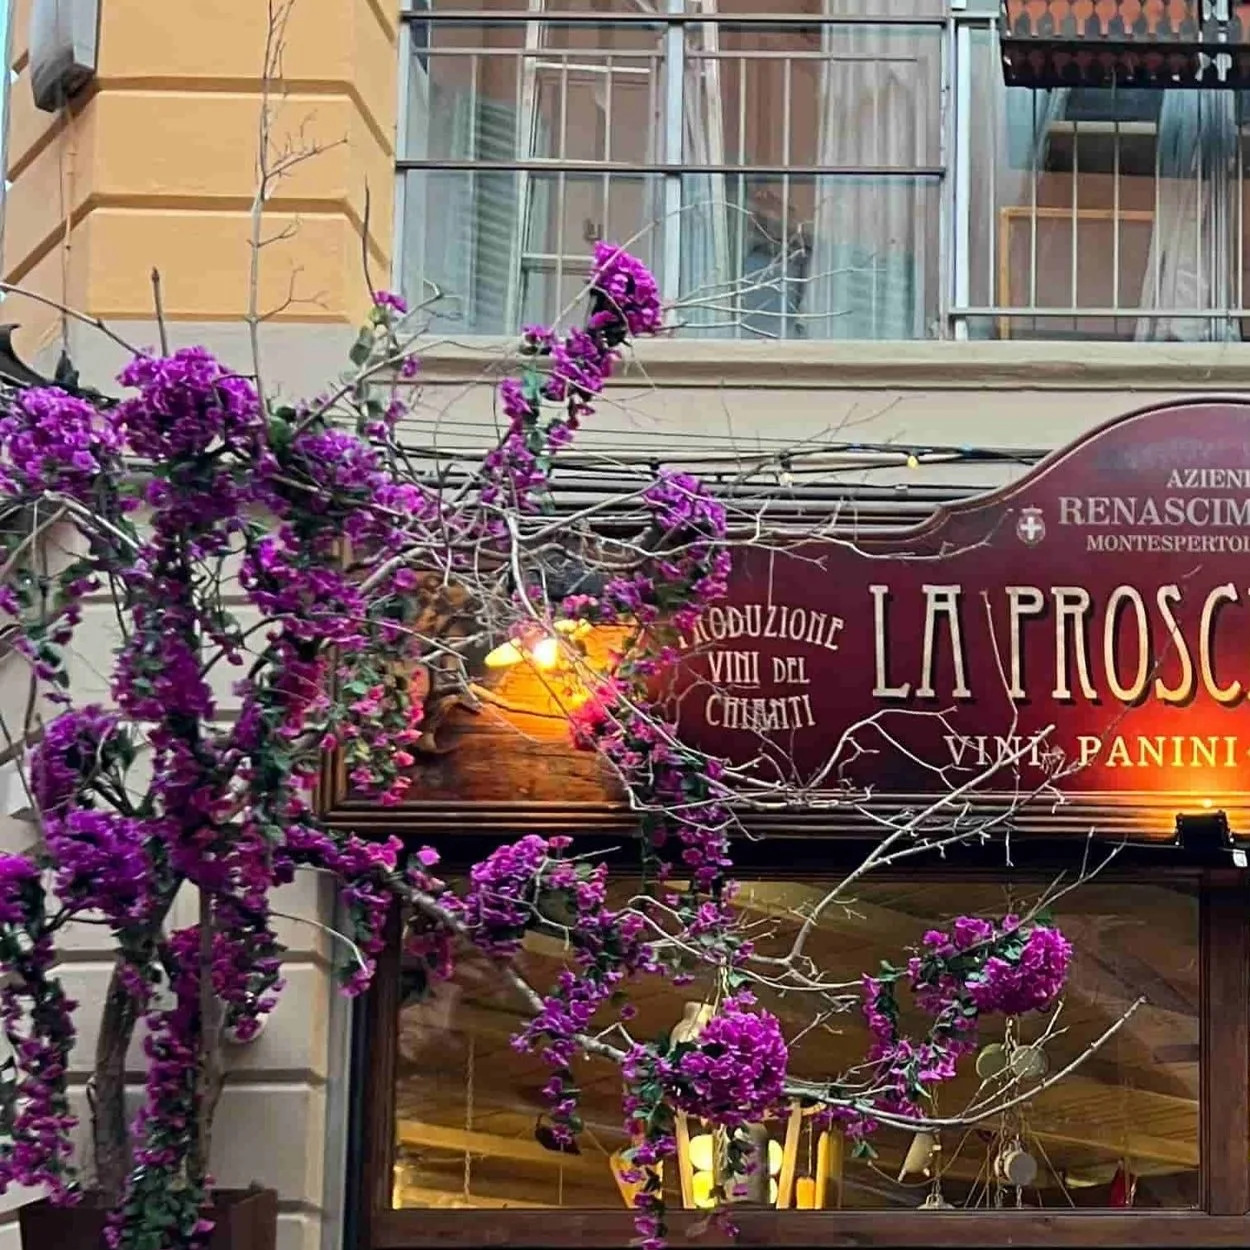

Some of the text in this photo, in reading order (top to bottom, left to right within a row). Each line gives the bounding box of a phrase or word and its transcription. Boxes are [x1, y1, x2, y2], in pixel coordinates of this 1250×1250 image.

[678, 604, 844, 651] RODUZIONE
[868, 583, 970, 700] LA
[708, 651, 811, 684] VINI DEL
[705, 693, 816, 730] CHIANTI
[943, 735, 1042, 768] VINI
[1077, 734, 1239, 768] PANINI
